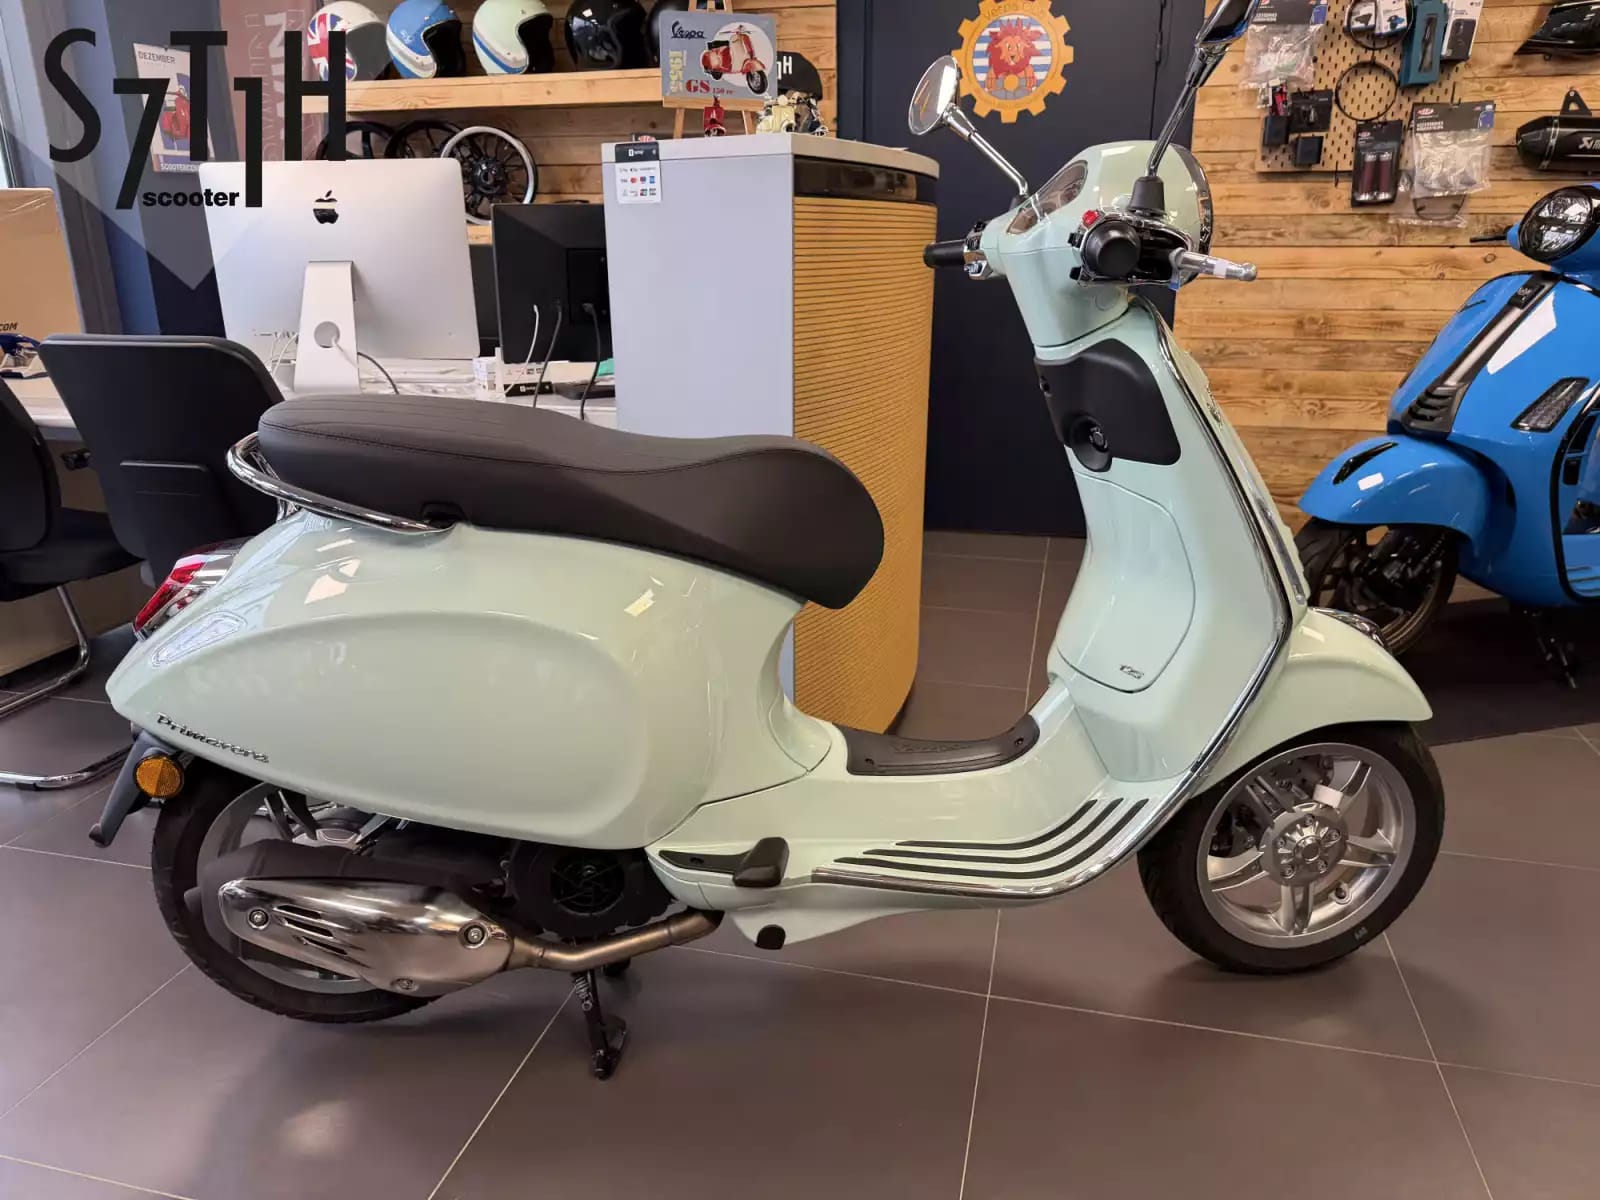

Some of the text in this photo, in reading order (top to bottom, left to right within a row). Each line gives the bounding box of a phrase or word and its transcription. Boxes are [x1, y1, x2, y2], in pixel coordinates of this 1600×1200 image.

[671, 20, 706, 40] Vespa
[137, 50, 176, 65] DEZEMBER
[685, 79, 710, 93] GS
[157, 711, 270, 764] Primavera
